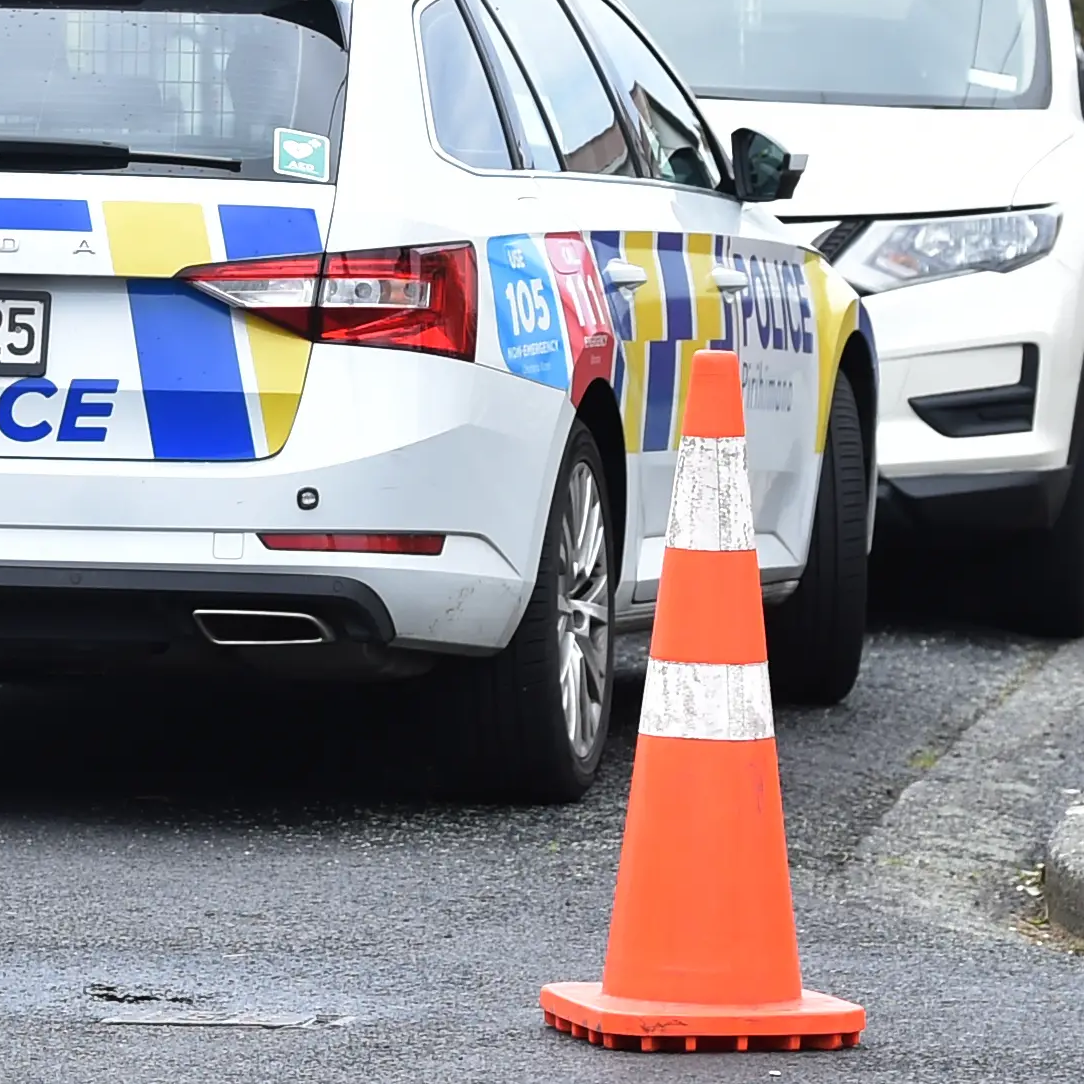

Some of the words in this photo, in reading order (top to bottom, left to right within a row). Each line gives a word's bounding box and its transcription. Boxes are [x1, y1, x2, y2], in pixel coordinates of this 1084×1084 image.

[508, 248, 525, 269] USE
[506, 278, 550, 336] 105
[566, 274, 605, 327] 111
[733, 253, 813, 354] POLICE
